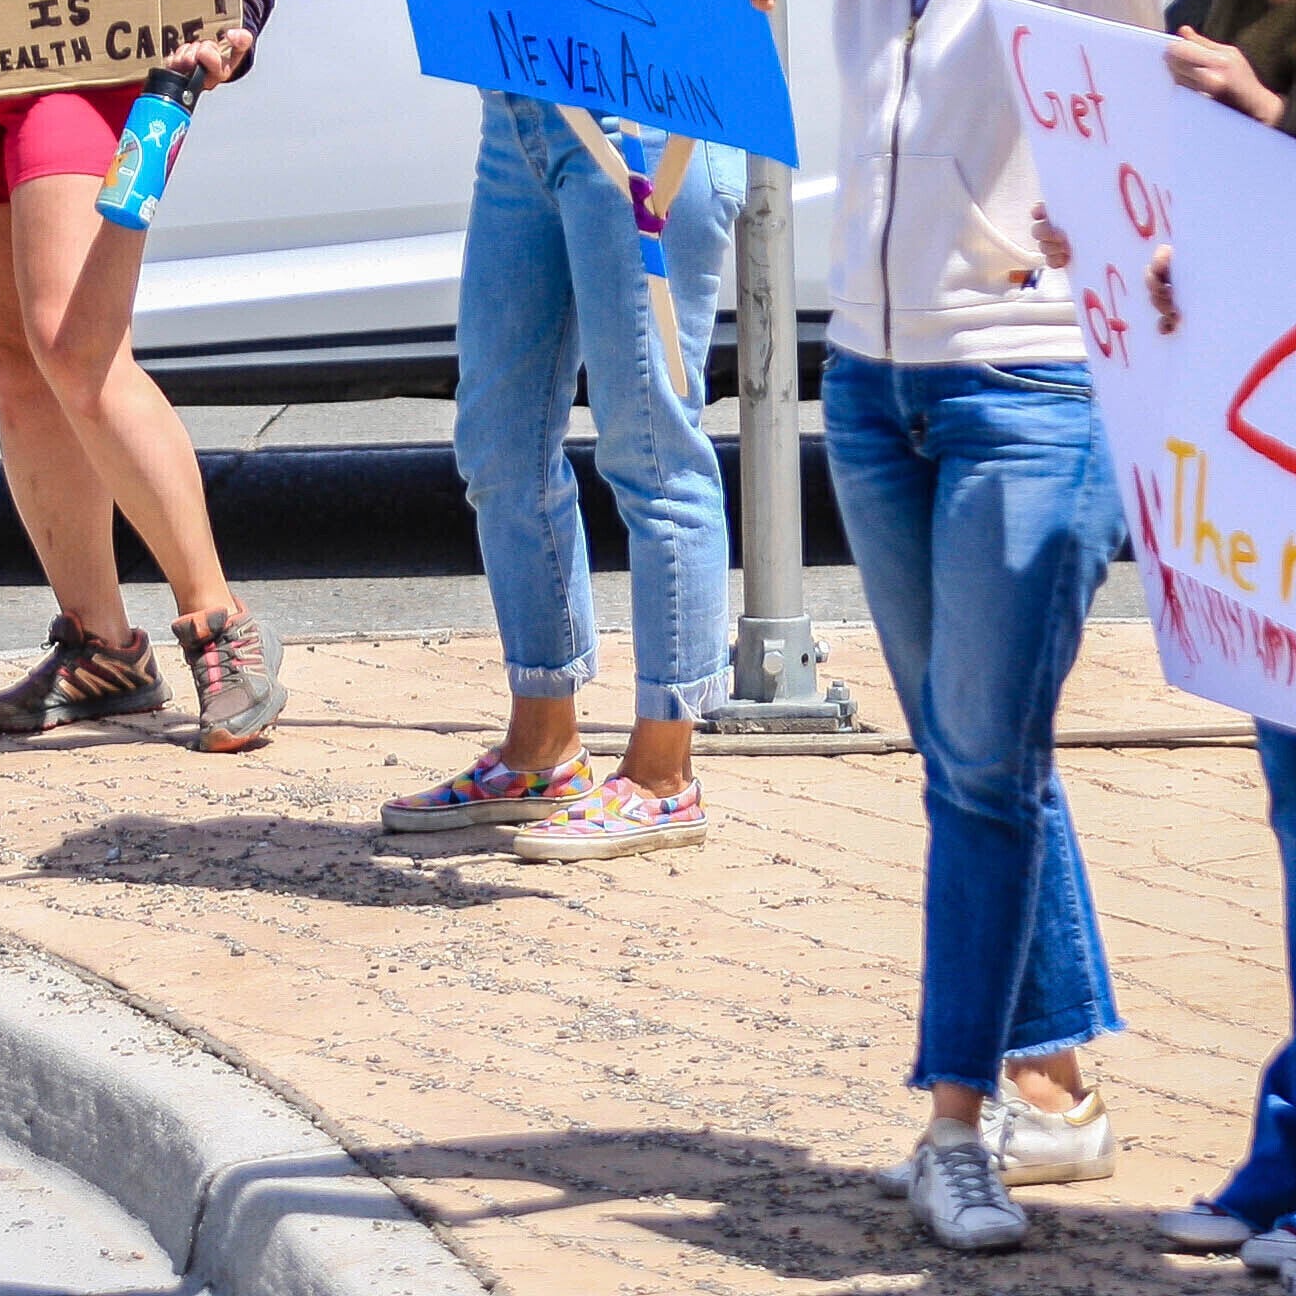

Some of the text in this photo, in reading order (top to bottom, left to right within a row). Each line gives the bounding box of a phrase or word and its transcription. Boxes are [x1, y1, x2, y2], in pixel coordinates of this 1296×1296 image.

[488, 10, 724, 129] NEVER AGAIN
[1083, 263, 1129, 368] of
[1164, 439, 1260, 592] The
